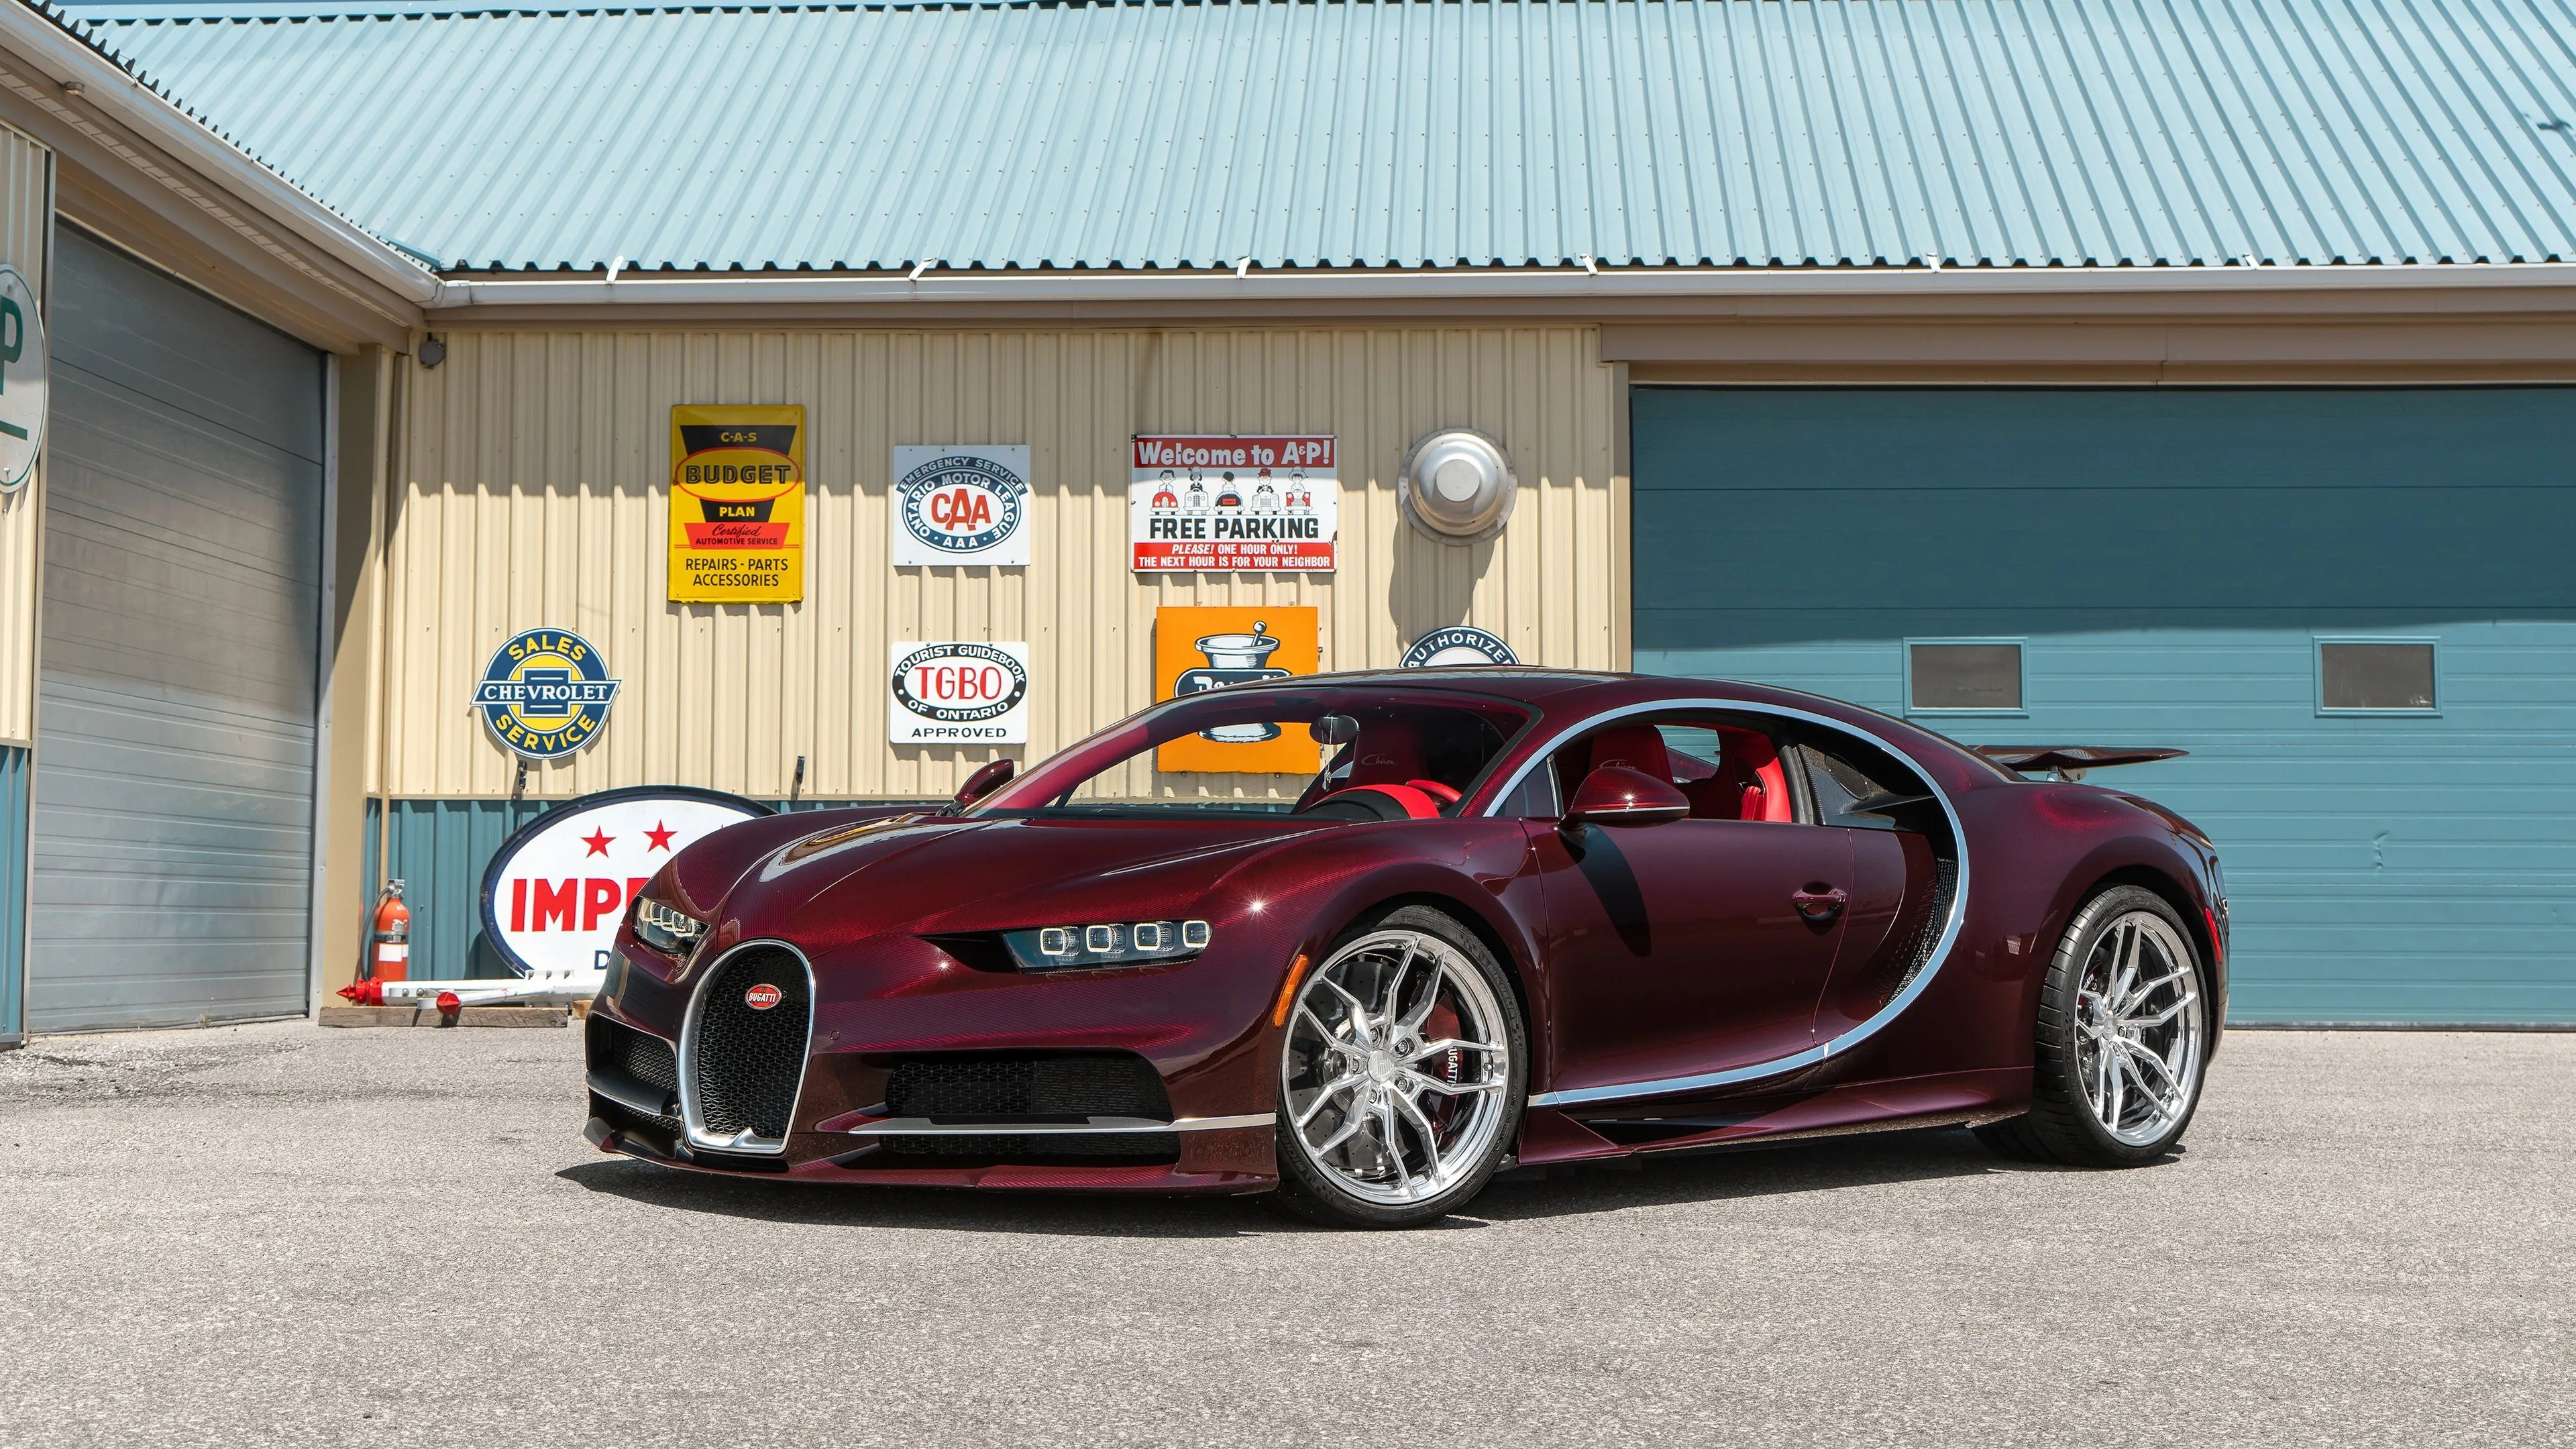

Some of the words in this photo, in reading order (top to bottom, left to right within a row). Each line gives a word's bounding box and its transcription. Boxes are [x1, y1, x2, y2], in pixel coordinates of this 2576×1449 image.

[720, 432, 757, 443] C-A-S
[1138, 441, 1246, 465] Welcome
[1250, 445, 1275, 465] to
[1281, 440, 1330, 465] A&P!
[686, 464, 791, 484] BUDGET
[900, 458, 969, 489] EMERGENCY
[975, 460, 1024, 491] SERVICE
[719, 506, 755, 517] PLAN
[908, 480, 936, 537] ONTARIO
[941, 473, 991, 488] MOTOR
[991, 484, 1015, 539] LEAGUE
[931, 488, 991, 531] CAA
[712, 523, 761, 537] Certified
[1150, 518, 1207, 539] FREE
[1214, 517, 1319, 539] PARKING
[943, 537, 979, 548] AAA
[1171, 544, 1214, 555] PLEASE!
[1218, 544, 1238, 555] ONE
[1240, 544, 1267, 555] HOUR
[1270, 544, 1297, 555] ONLY!
[686, 558, 737, 570] REPAIRS
[748, 558, 788, 571] PARTS
[1138, 557, 1159, 568] THE
[1161, 557, 1185, 568] NEXT
[1189, 557, 1215, 567] HOUR
[1219, 557, 1228, 567] IS
[1232, 557, 1250, 567] FOR
[1253, 557, 1279, 568] YOUR
[1282, 556, 1330, 568] NEIGHBOR
[692, 574, 779, 586] ACCESSORIES
[508, 635, 587, 661] SALES
[895, 646, 955, 678] TOURIST
[958, 645, 1025, 684] GUIDEBOOK
[484, 685, 608, 700] CHEVROLET
[914, 666, 1002, 700] TGBO
[908, 700, 928, 713] OF
[936, 702, 1008, 720] ONTARIO
[496, 714, 596, 751] SERVICE
[912, 727, 1007, 738] APPROVED
[749, 993, 777, 1003] BUGATTI
[1447, 1046, 1458, 1083] UGATTI
